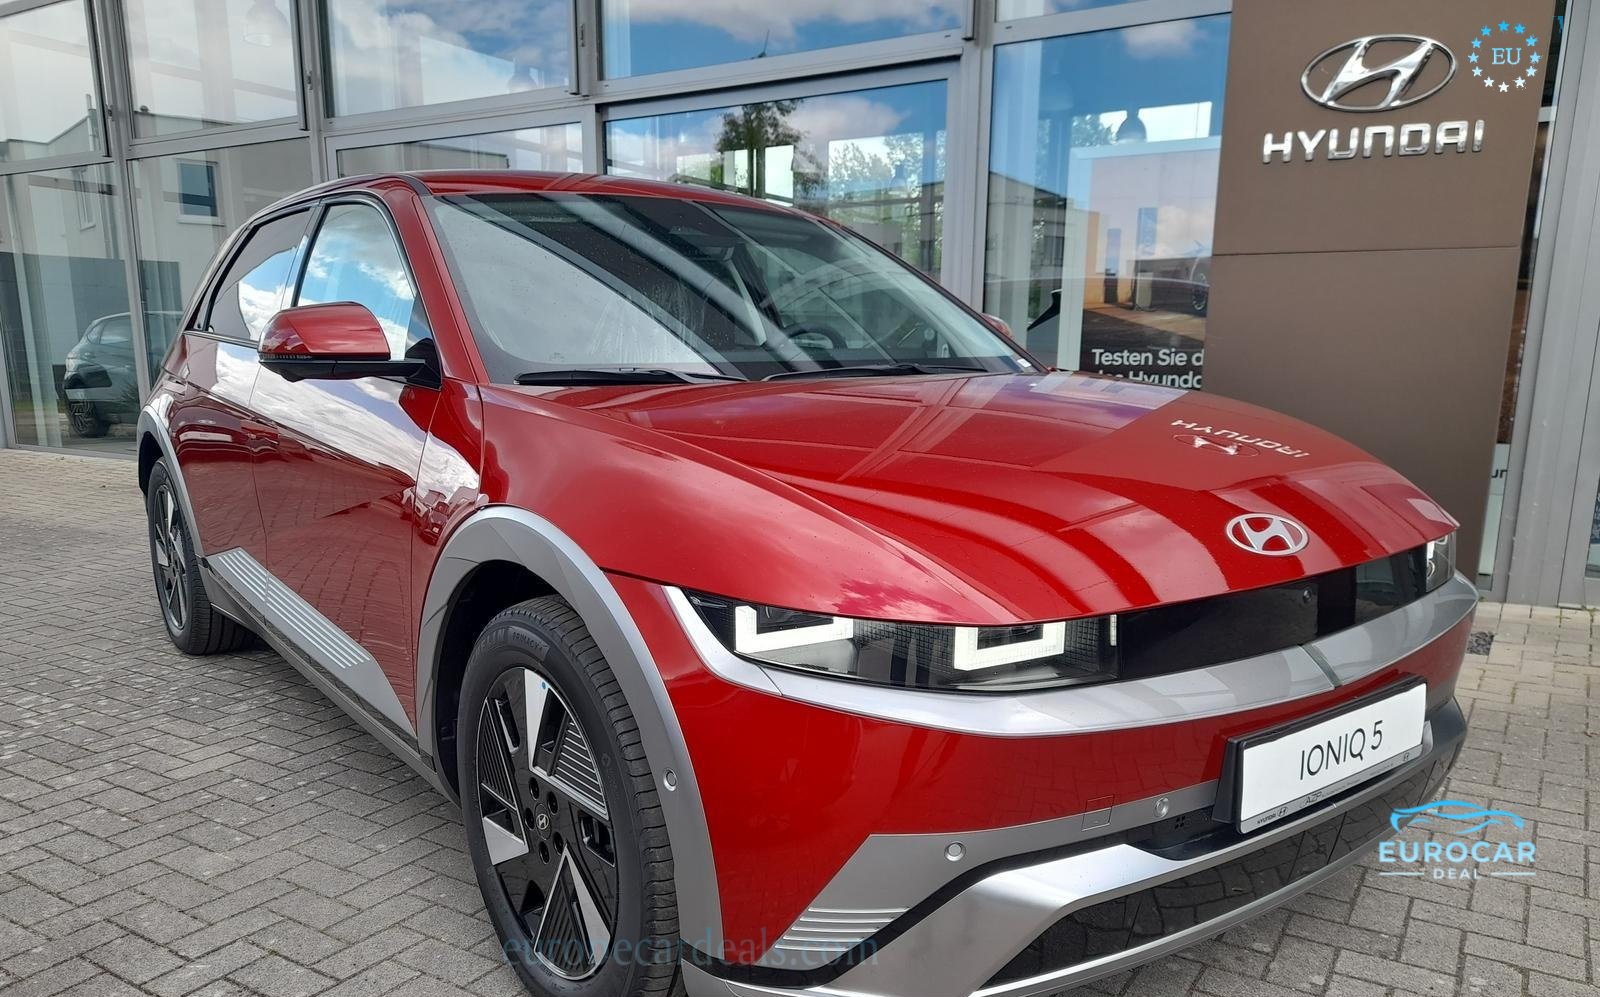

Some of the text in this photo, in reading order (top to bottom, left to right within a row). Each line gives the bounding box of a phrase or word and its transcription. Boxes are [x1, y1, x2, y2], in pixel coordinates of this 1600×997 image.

[1262, 119, 1485, 164] HYUNDAI
[1091, 348, 1153, 366] Testen
[1157, 348, 1188, 366] Sie
[1299, 719, 1383, 781] IONIQ 5
